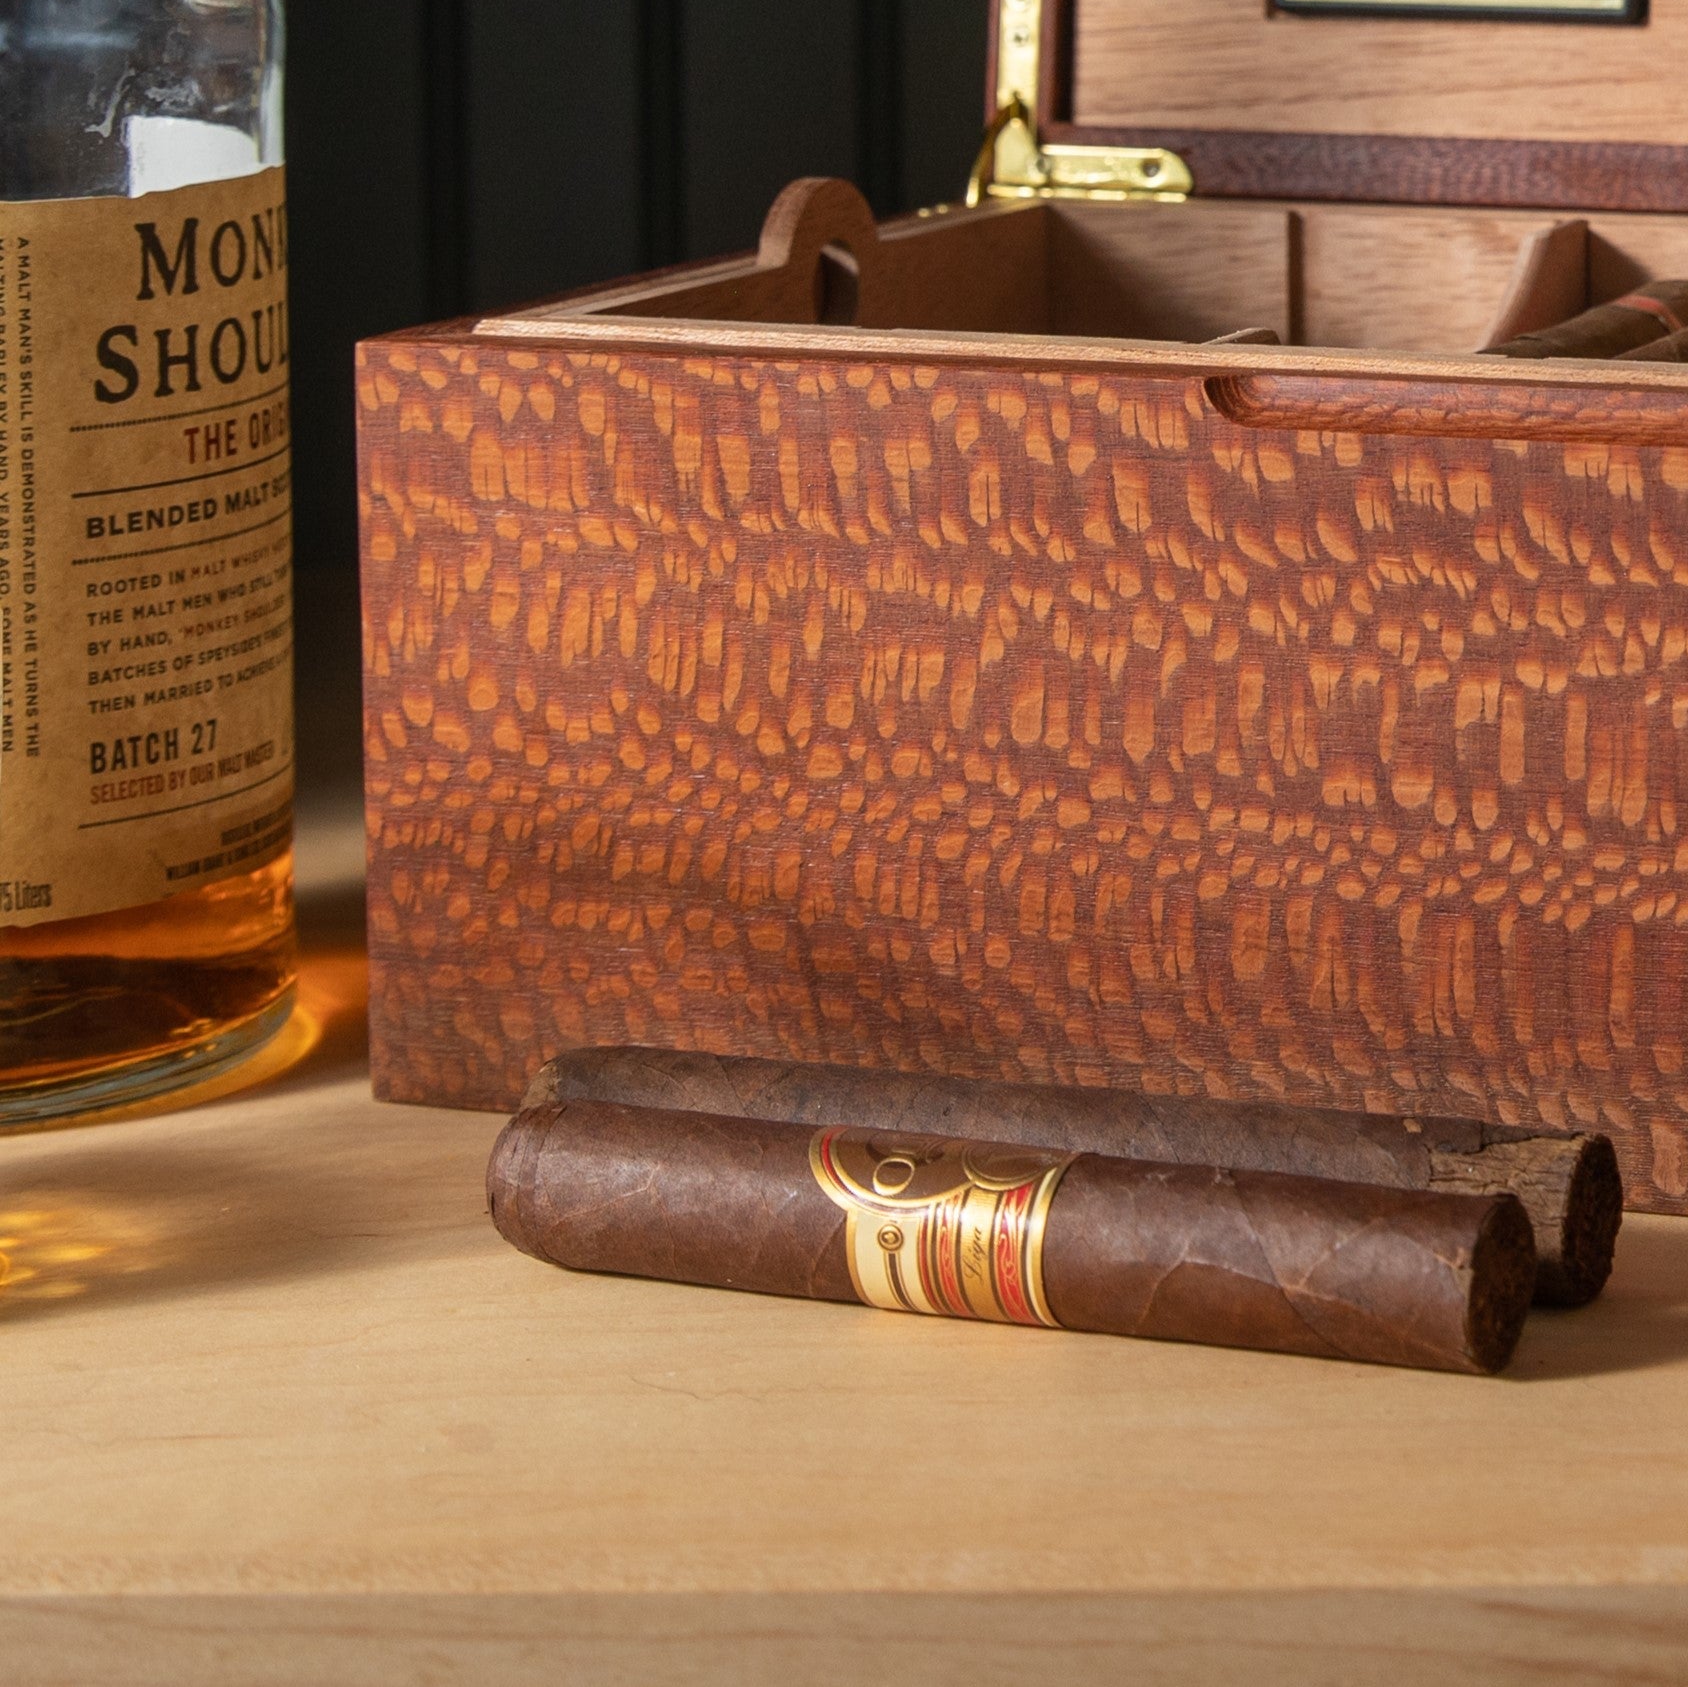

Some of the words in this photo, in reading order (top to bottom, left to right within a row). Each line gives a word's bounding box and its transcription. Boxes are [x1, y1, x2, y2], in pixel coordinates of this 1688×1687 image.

[18, 237, 31, 250] A
[18, 254, 32, 302] MALT
[19, 308, 33, 365] MAN'S
[20, 370, 34, 422] SKILL
[21, 426, 34, 443] IS
[183, 419, 239, 465] THE
[21, 448, 37, 595] DEMONSTRATED
[86, 498, 218, 540] BLENDED
[225, 481, 270, 515] MALT
[86, 573, 163, 598] ROOTED
[168, 568, 187, 585] IN
[190, 559, 227, 578] MALT
[23, 601, 38, 624] AS
[87, 608, 124, 627] THE
[132, 600, 176, 621] MALT
[181, 592, 213, 611] MEN
[25, 630, 38, 654] HE
[87, 639, 112, 657] BY
[119, 631, 173, 652] HAND,
[25, 658, 40, 717] TURNS
[87, 659, 168, 686] BATCHES
[172, 653, 195, 672] OF
[87, 695, 137, 714] THEN
[143, 679, 214, 706] MARRIED
[2, 714, 14, 752] MEN
[26, 723, 40, 758] THE
[90, 727, 180, 775] BATCH
[190, 717, 219, 756] 27
[90, 772, 165, 805] SELECTED
[168, 768, 188, 792] BY
[15, 879, 53, 911] Liters
